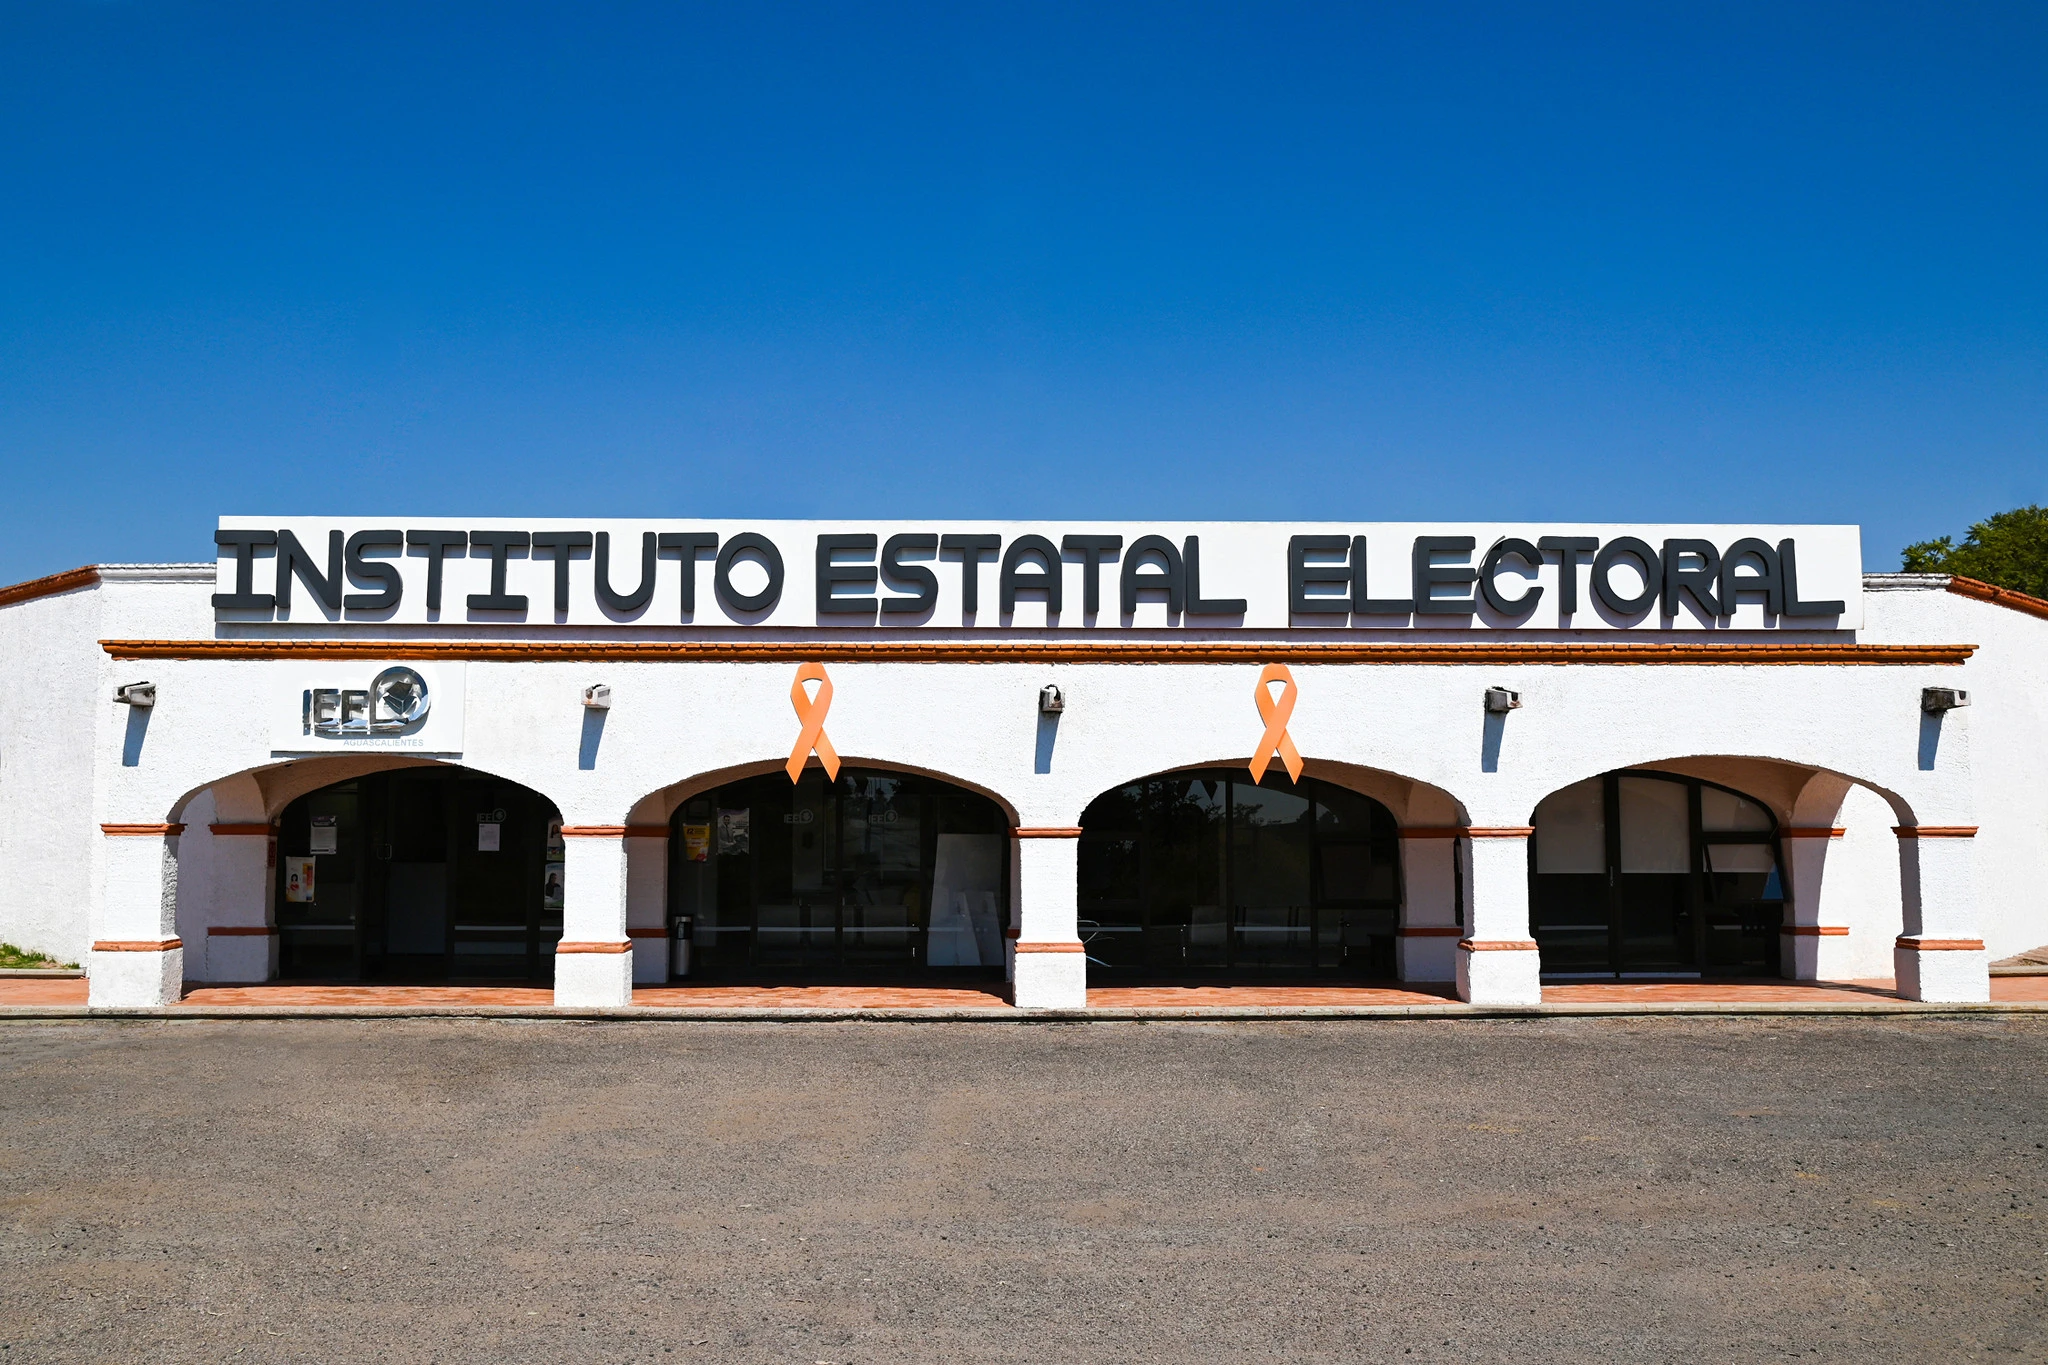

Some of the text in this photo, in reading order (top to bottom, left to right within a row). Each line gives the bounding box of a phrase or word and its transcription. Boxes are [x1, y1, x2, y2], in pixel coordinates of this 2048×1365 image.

[211, 529, 1845, 616] INSTITUTO ESTATAL ELECTORAL
[343, 738, 424, 747] AGUASCALIENTES
